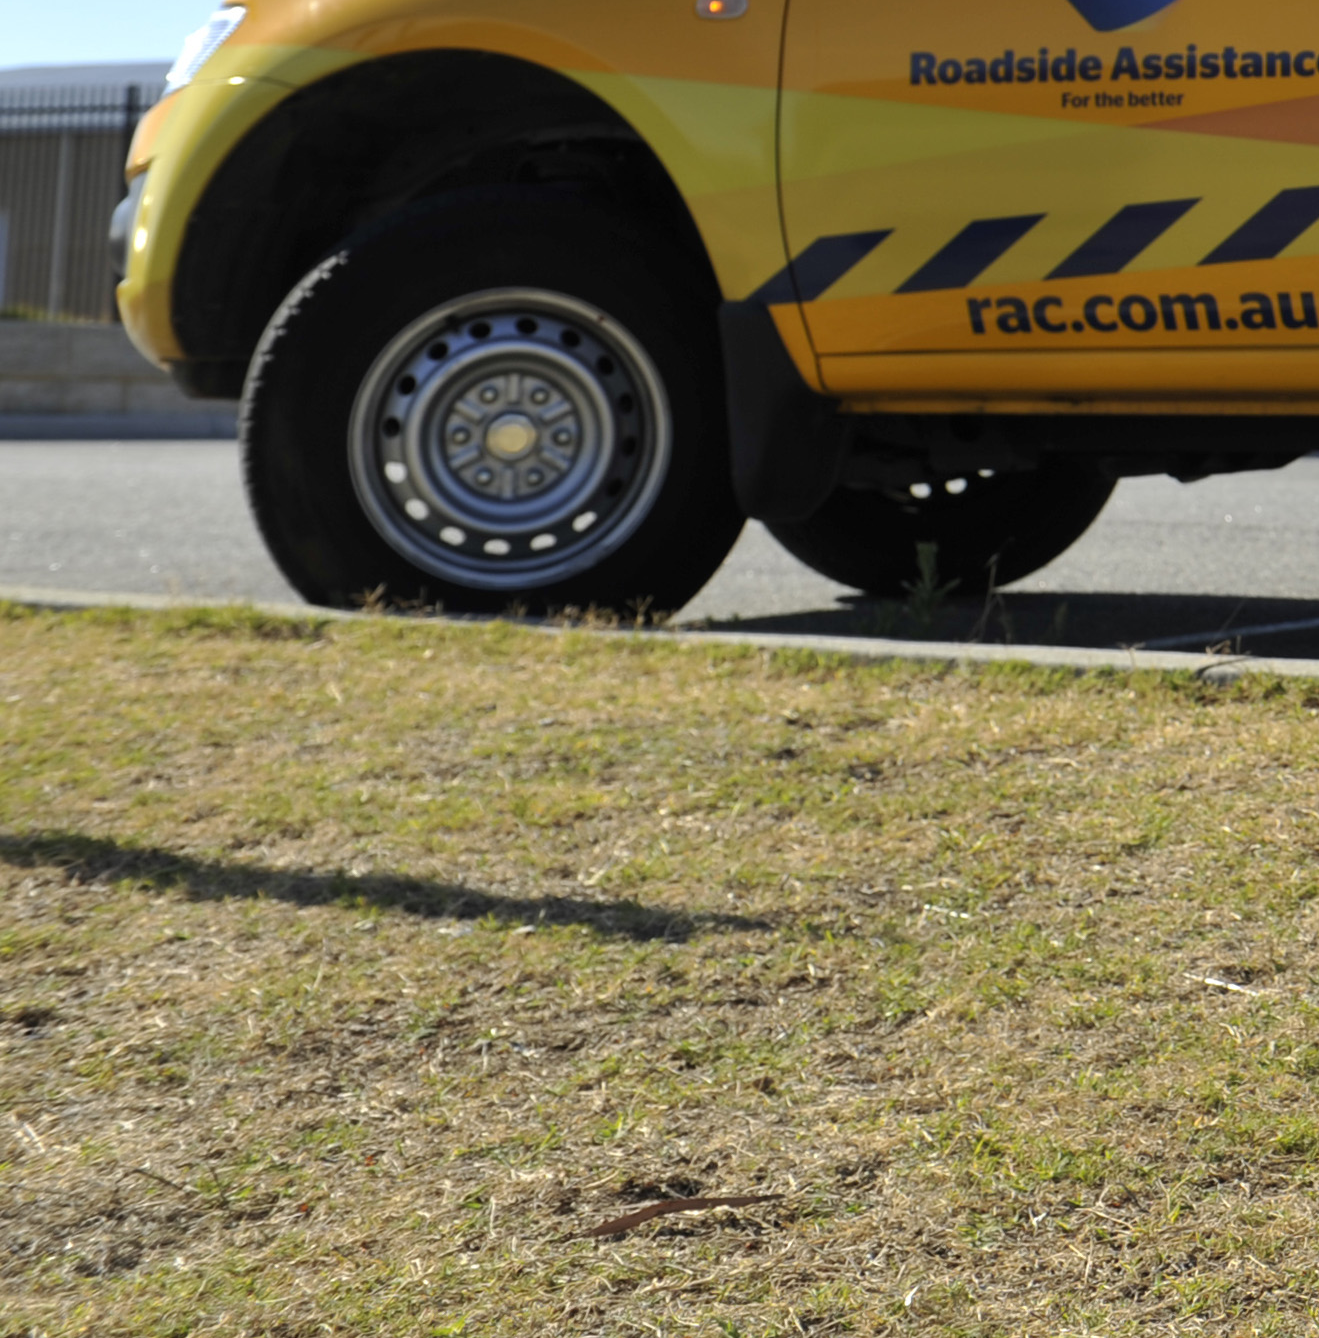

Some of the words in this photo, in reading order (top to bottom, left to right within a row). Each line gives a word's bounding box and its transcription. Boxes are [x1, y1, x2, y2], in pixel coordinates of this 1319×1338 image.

[909, 48, 1103, 86] Roadside
[1061, 91, 1091, 108] For
[1094, 92, 1124, 108] the
[1128, 90, 1185, 108] better
[966, 291, 1319, 335] rac.com.au
